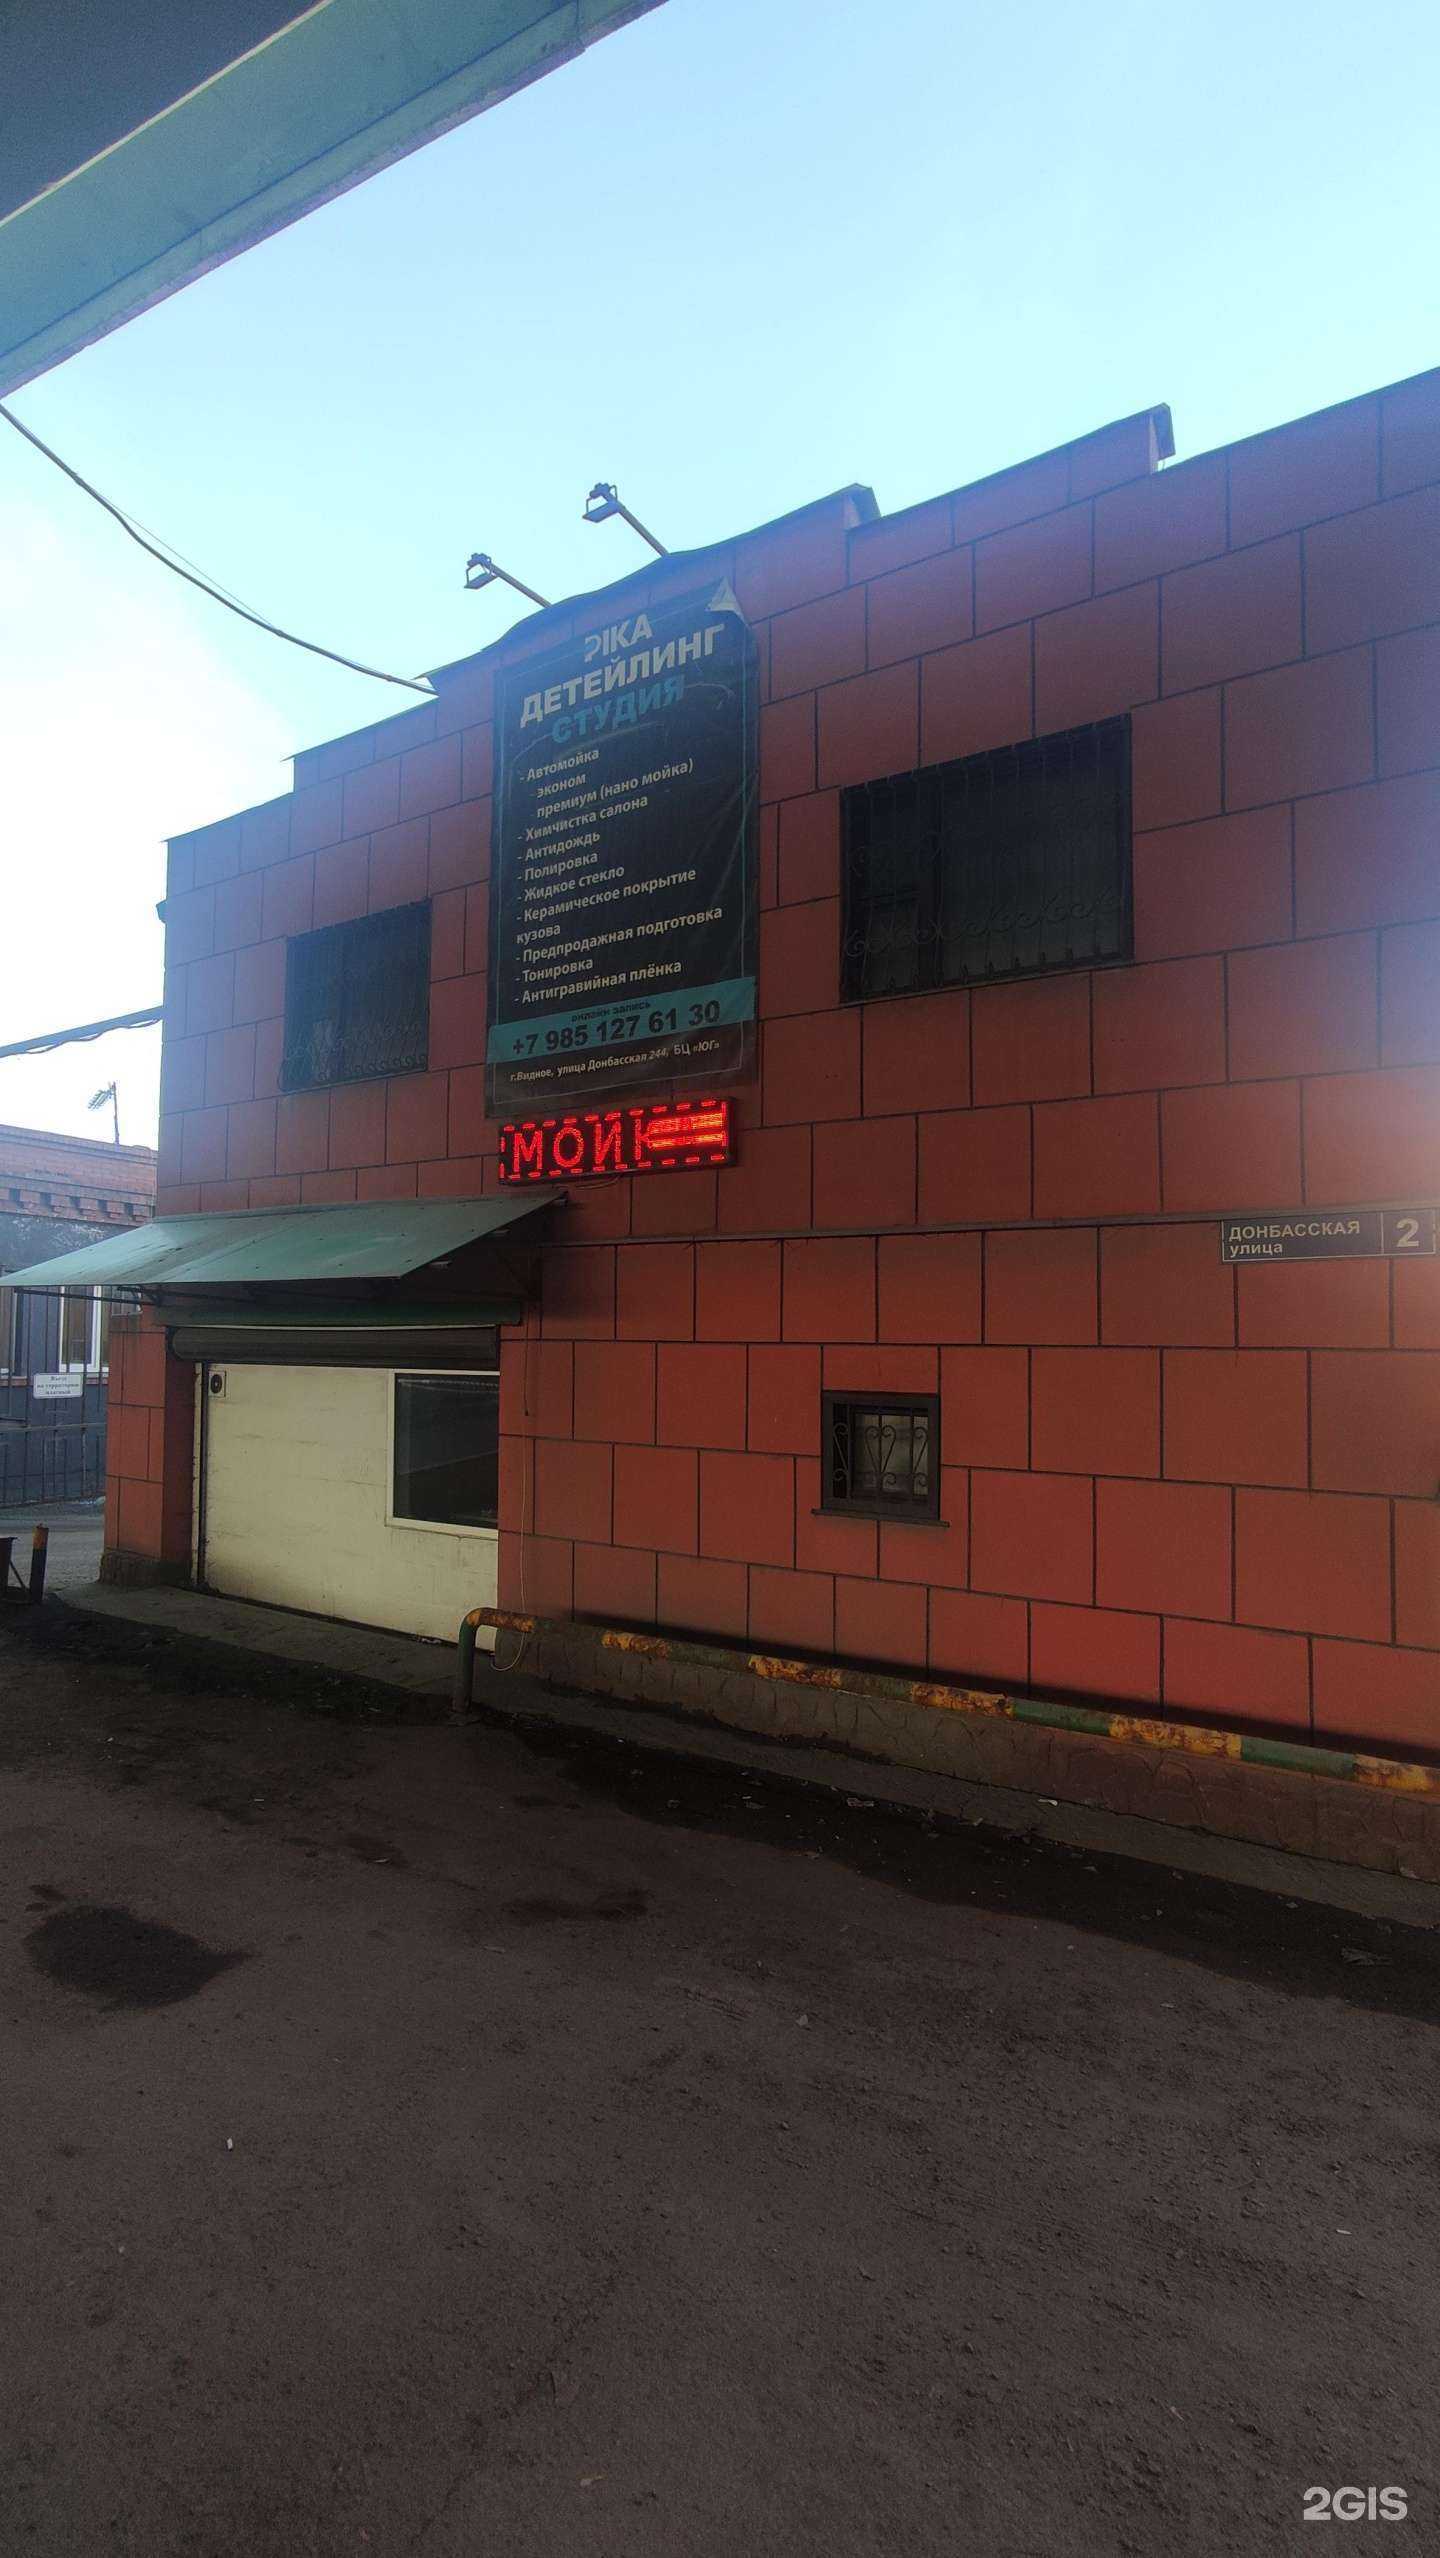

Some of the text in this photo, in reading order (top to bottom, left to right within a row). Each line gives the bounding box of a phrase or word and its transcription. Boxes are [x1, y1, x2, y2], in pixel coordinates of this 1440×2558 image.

[520, 624, 725, 728] ДЕТЕЙЛИНГ
[552, 674, 685, 743] СТУДИЯ
[527, 749, 600, 782] Автомойка
[537, 774, 586, 799] эконом
[537, 758, 694, 819] премиум (нано мойка)
[525, 796, 648, 842] Химчистка салона
[525, 833, 600, 862] Антидождь
[524, 853, 598, 882] Полировка
[524, 866, 625, 902] Жидкое стекло
[524, 869, 696, 922] Керамическое покрытие
[516, 924, 561, 946] кузова
[523, 907, 723, 964] Предпродажная подготовка
[522, 958, 593, 983] Тонировка
[522, 960, 682, 1004] Антигравийная плёнка
[512, 1000, 721, 1055] +7 985 127 61 30
[557, 1062, 586, 1078] улица
[587, 1053, 647, 1073] Донбасская
[673, 1043, 690, 1057] БЦ
[1229, 1220, 1360, 1242] ДОНБАССКАЯ
[1396, 1218, 1420, 1247] 2
[1230, 1242, 1283, 1258] улица
